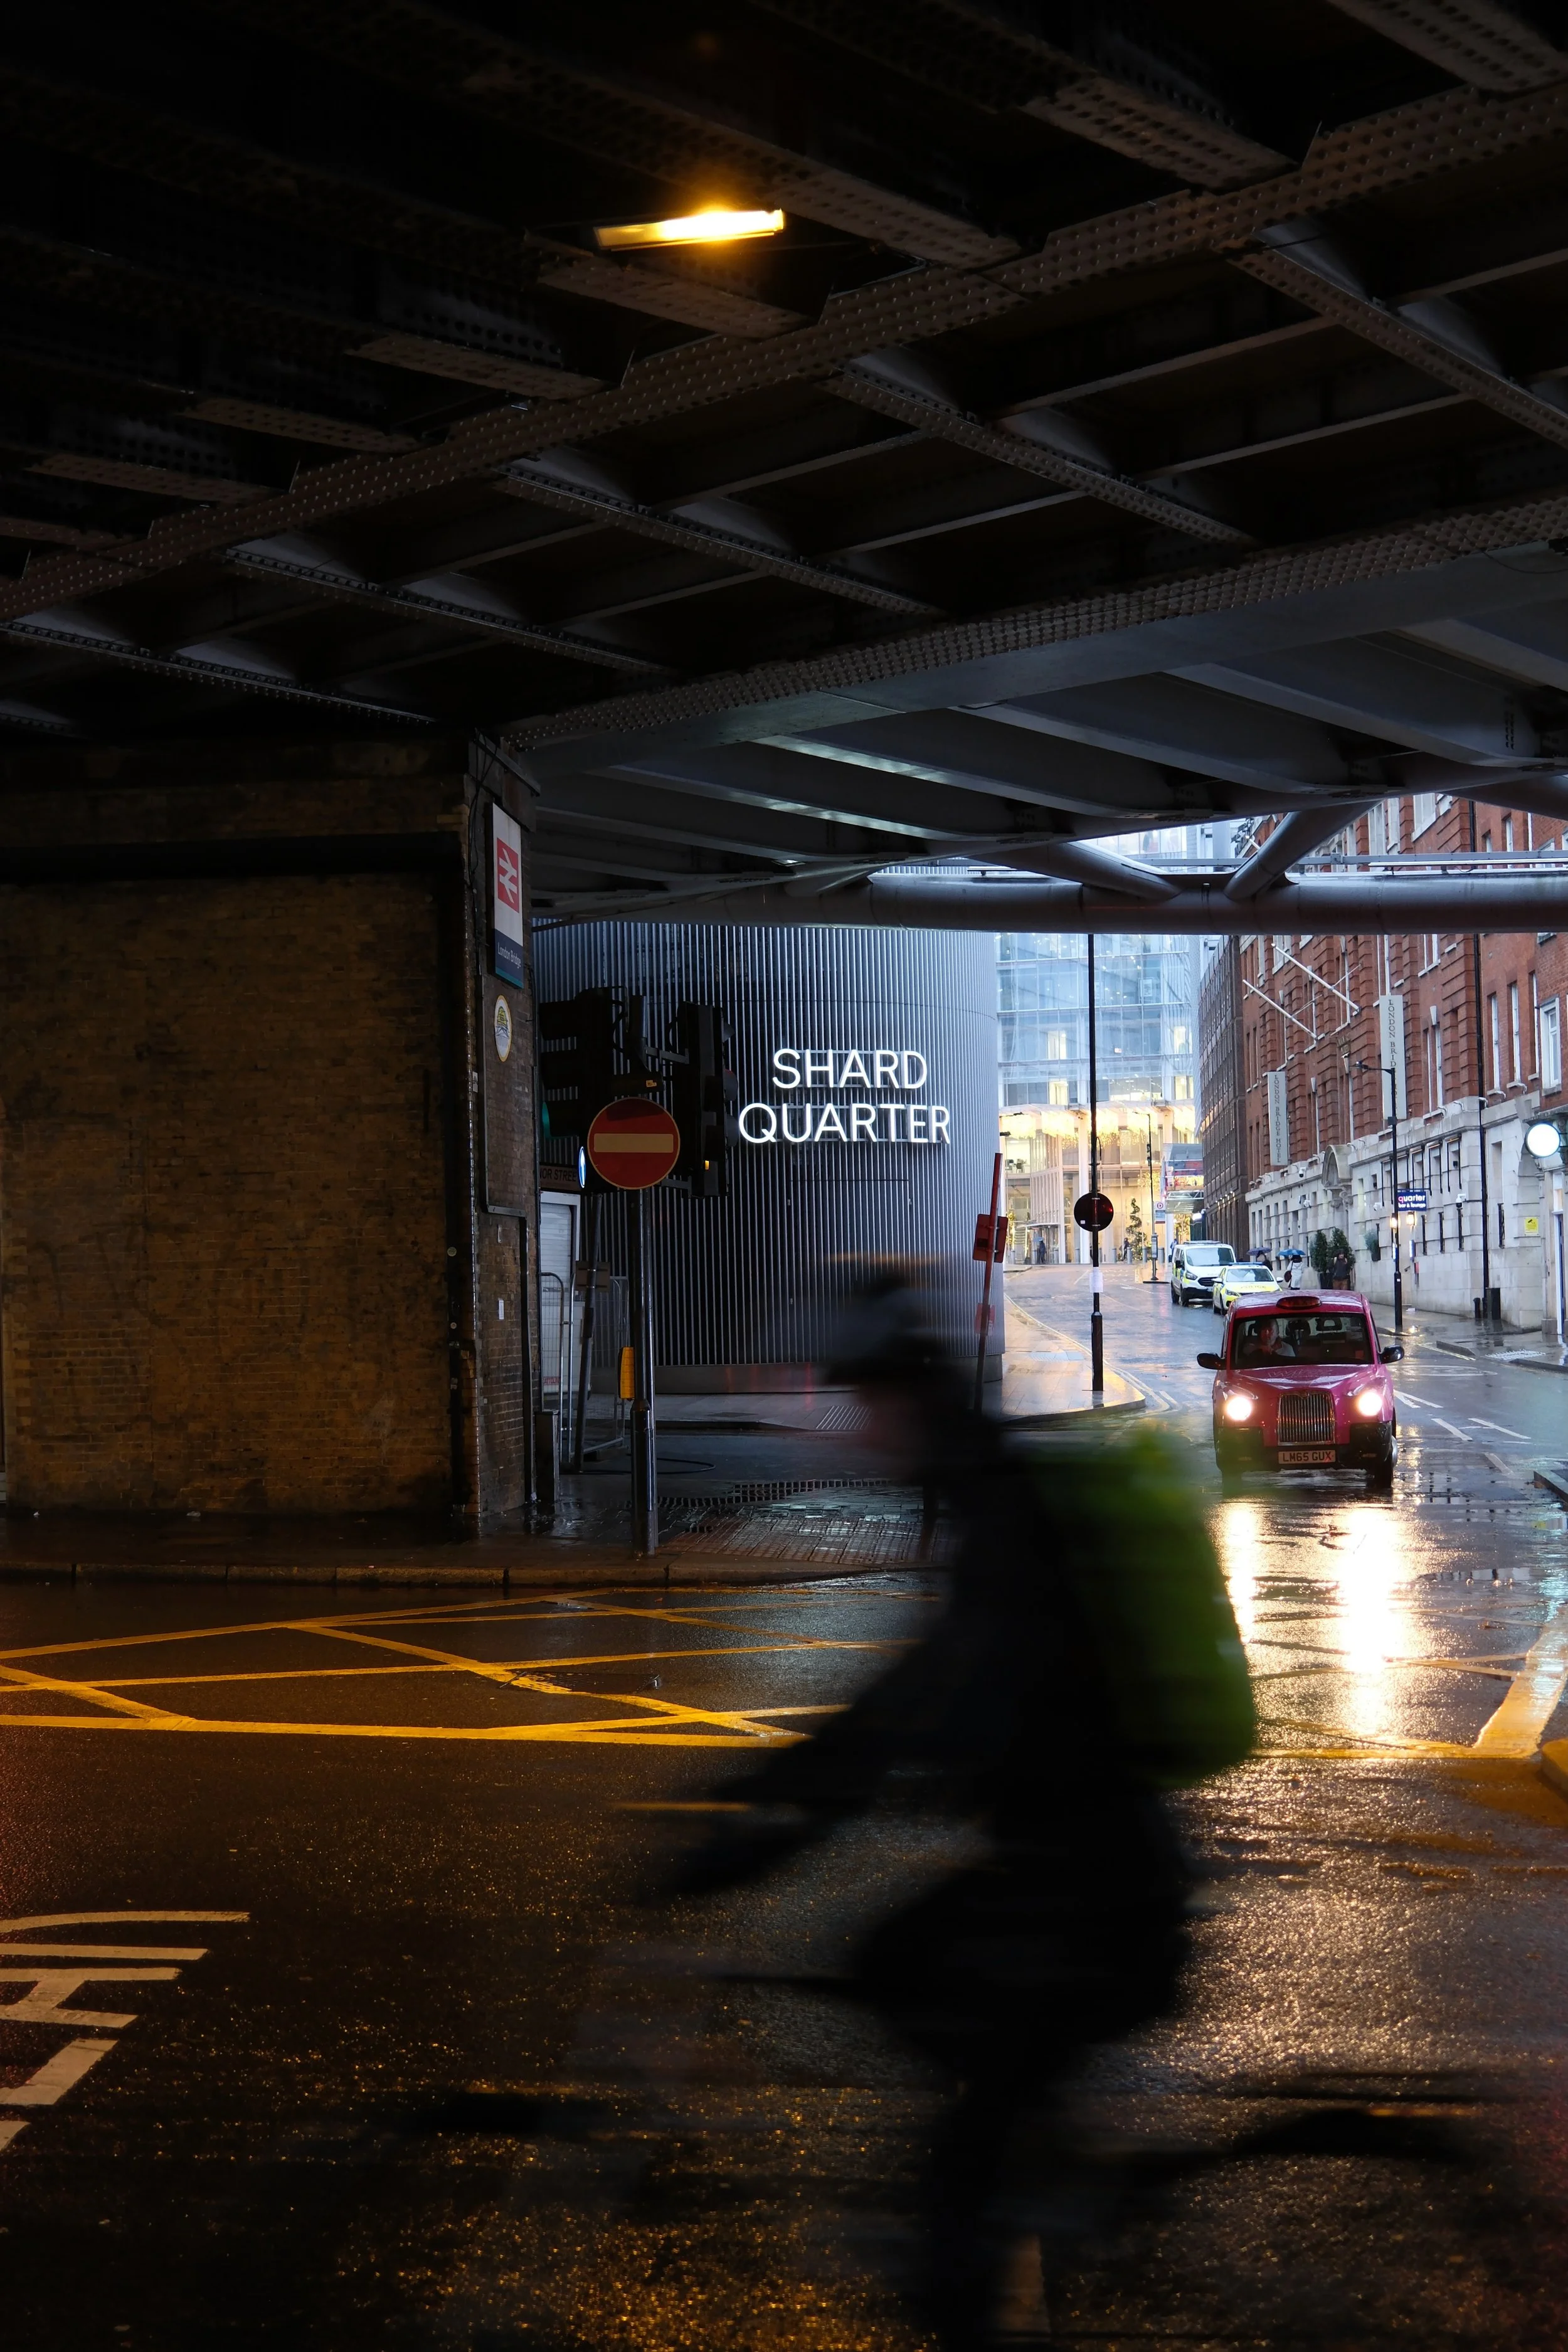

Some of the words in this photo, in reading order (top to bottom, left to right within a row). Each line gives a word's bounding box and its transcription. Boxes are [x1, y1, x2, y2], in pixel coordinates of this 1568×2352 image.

[497, 942, 511, 960] London
[511, 950, 521, 969] Bridge
[772, 1048, 928, 1089] SHARD
[738, 1102, 950, 1144] QUARTER
[554, 1169, 576, 1182] STREE
[1398, 1194, 1426, 1204] quarter
[1283, 1452, 1309, 1462] LM65
[1312, 1451, 1332, 1461] GUX
